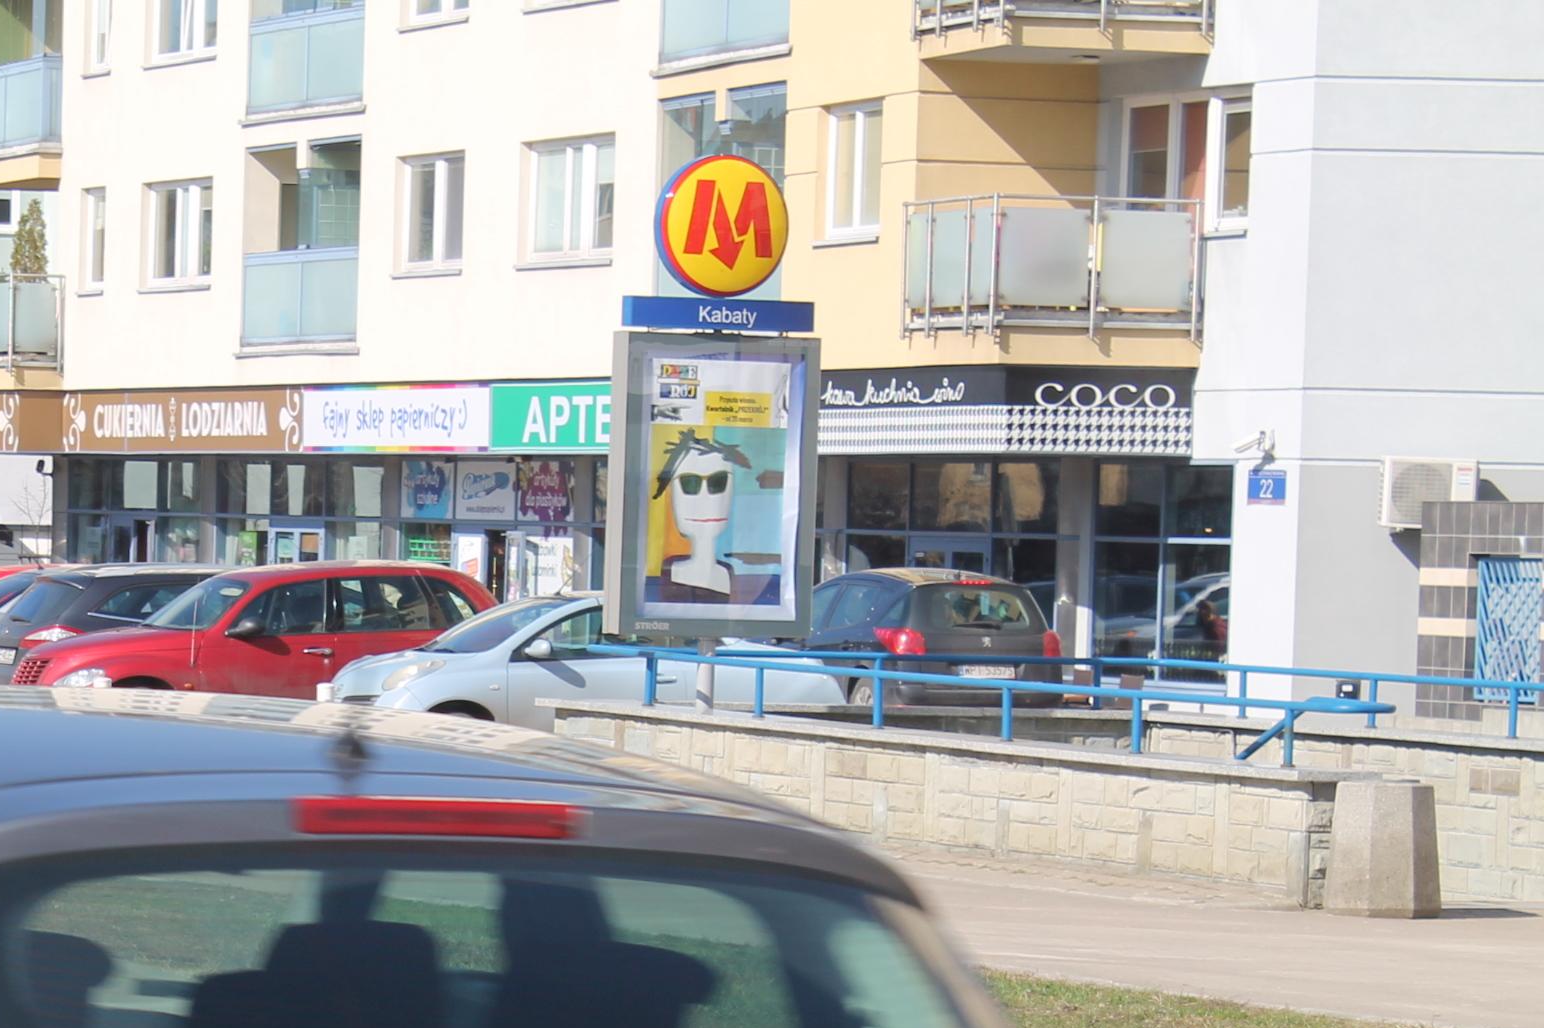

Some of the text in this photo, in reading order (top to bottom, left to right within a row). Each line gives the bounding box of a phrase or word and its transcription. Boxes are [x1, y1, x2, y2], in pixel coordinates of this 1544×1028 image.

[698, 305, 757, 328] Kabaty
[821, 377, 965, 406] kawa kuchnia wino
[93, 403, 165, 438] CUKIERNIA
[180, 401, 267, 437] LODZIARNIA
[322, 401, 350, 438] fajny
[355, 401, 384, 437] sklep
[1259, 478, 1274, 498] 22
